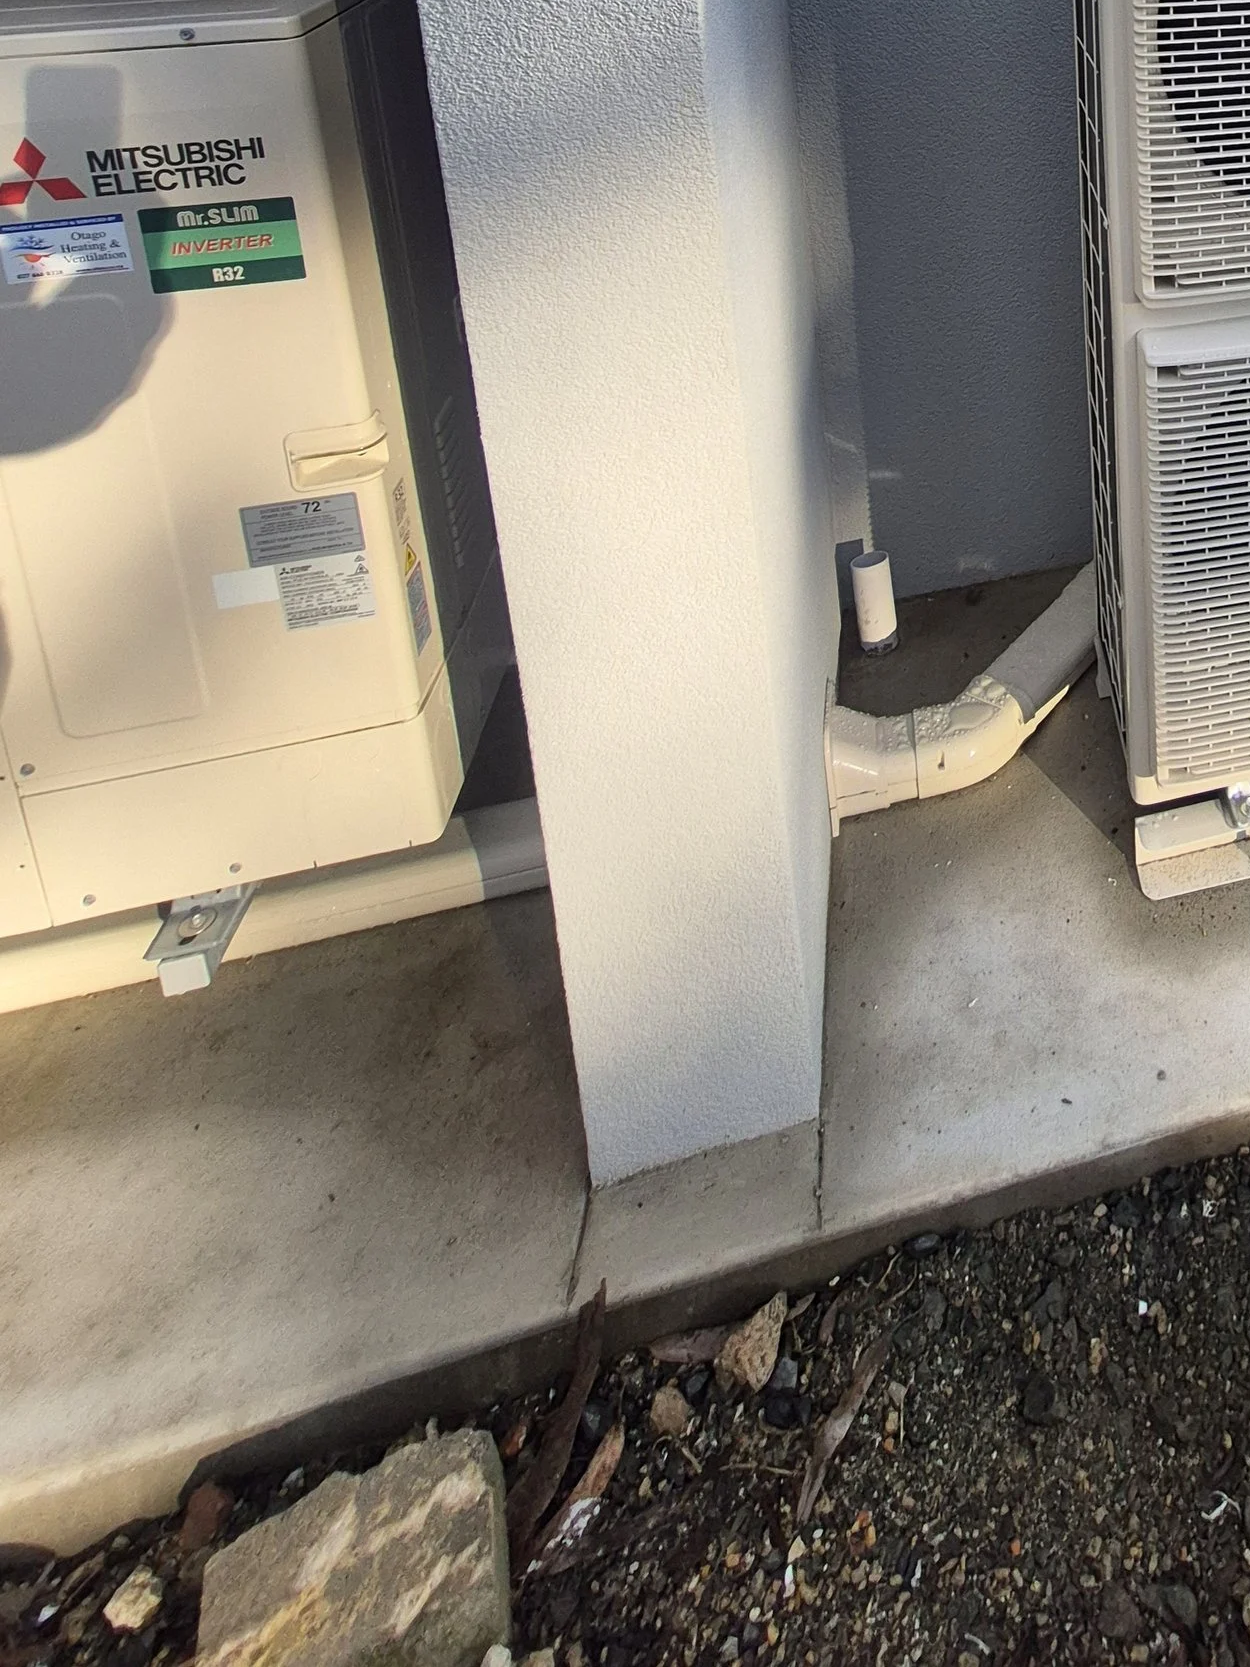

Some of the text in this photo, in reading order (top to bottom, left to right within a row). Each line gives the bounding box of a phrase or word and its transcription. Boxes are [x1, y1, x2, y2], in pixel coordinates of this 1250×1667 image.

[86, 137, 265, 173] MITSUBISHI
[92, 163, 247, 197] ELECTRIC
[70, 231, 107, 241] Otago
[60, 239, 121, 254] Heating &
[171, 234, 274, 257] INVERTER
[64, 251, 128, 264] Ventilation
[212, 266, 246, 283] R32
[301, 500, 322, 514] 72
